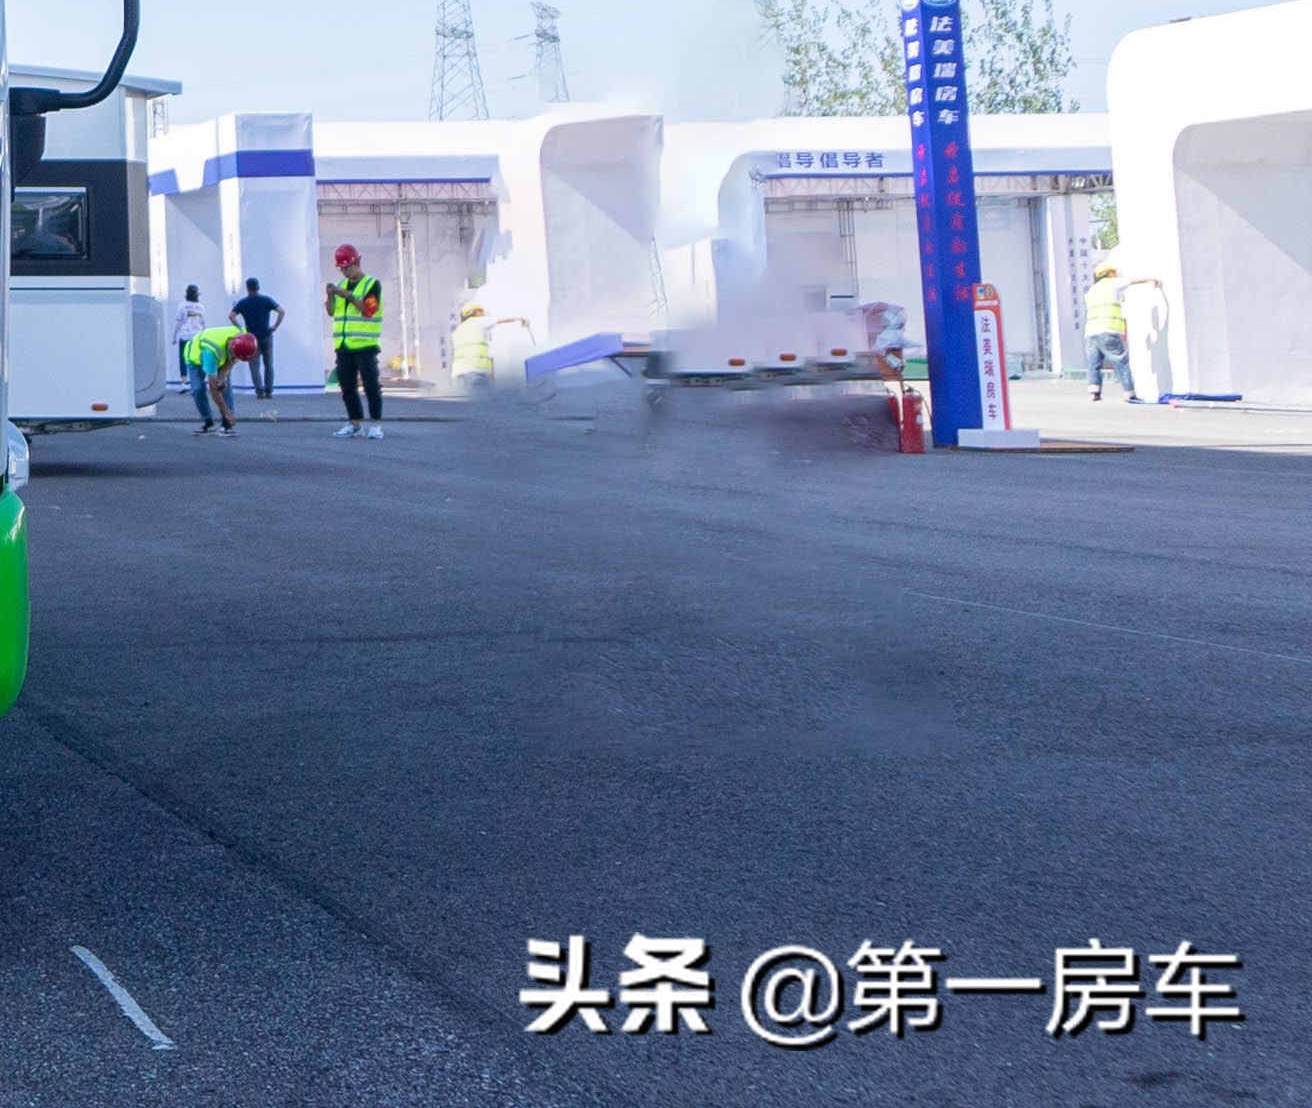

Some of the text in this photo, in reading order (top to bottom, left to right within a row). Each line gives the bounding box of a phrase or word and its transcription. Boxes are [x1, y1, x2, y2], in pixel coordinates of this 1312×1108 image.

[930, 15, 960, 125] 法美瑞房车
